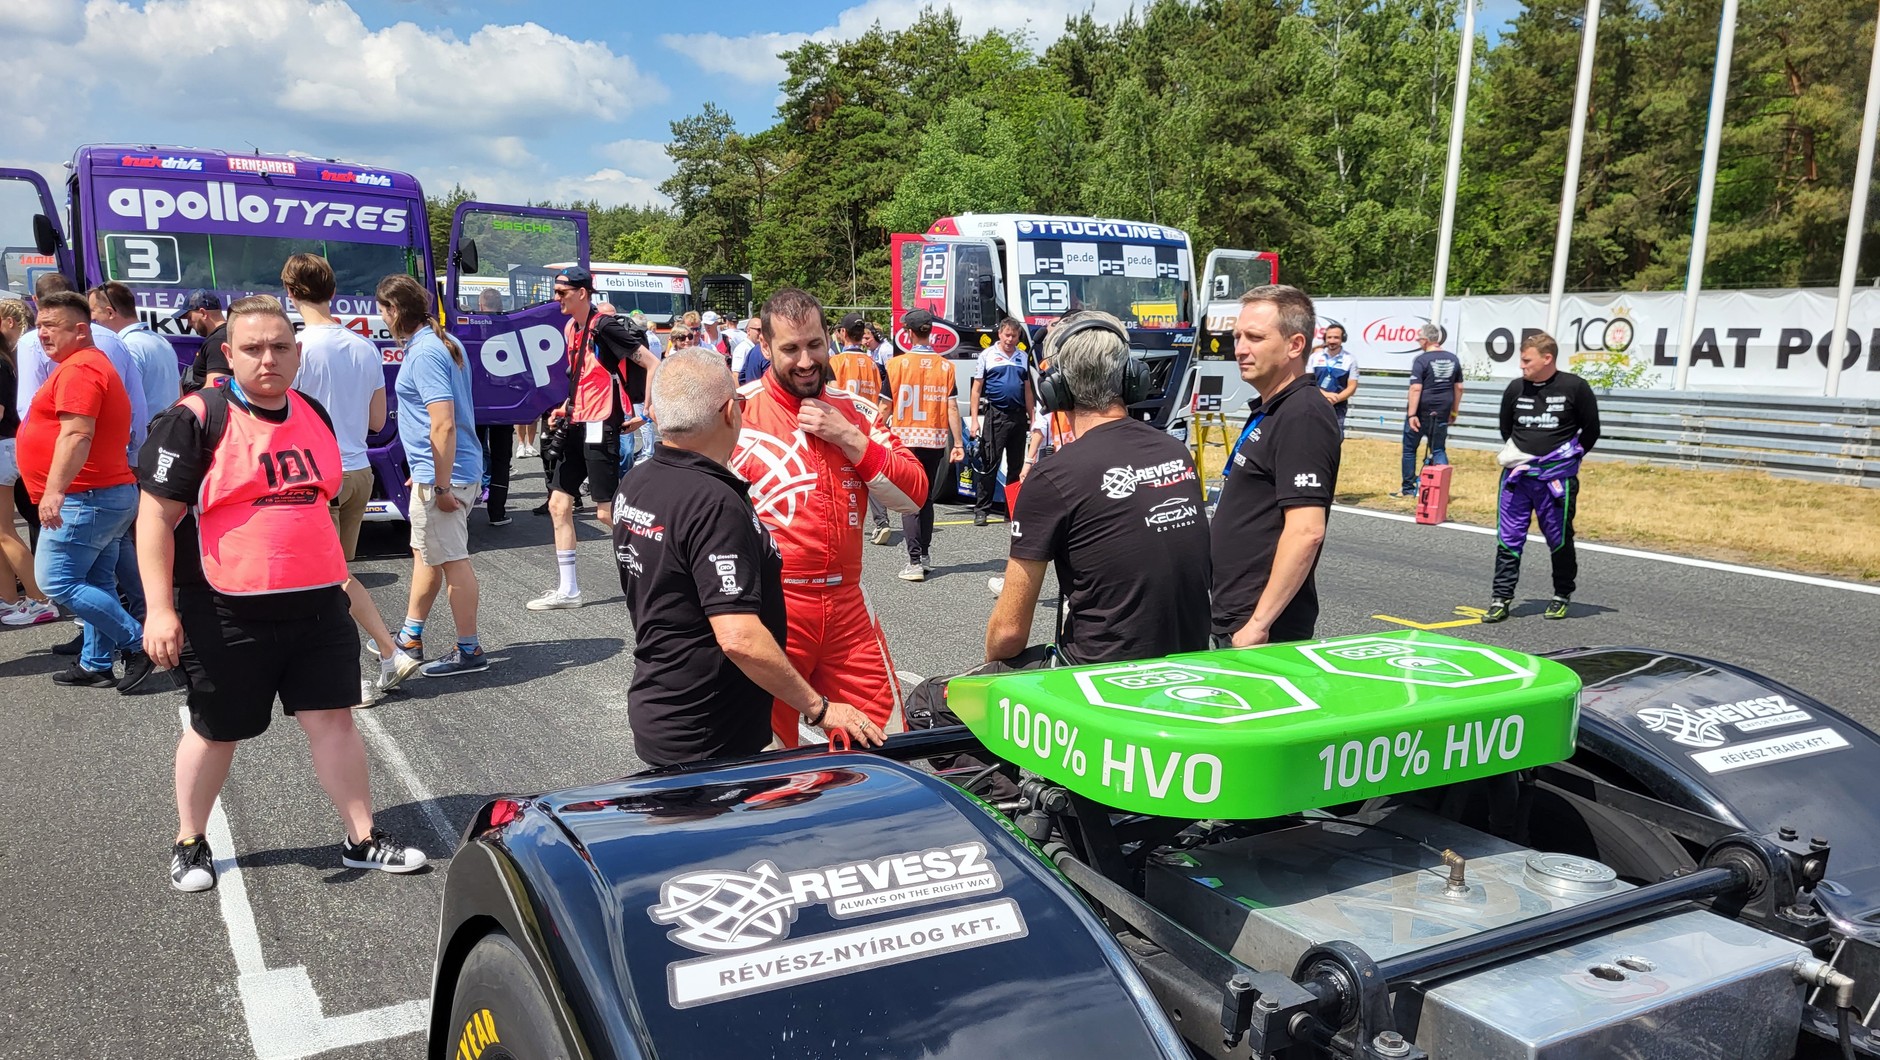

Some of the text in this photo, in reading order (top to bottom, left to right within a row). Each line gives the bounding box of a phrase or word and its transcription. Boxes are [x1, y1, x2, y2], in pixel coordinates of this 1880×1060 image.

[229, 157, 295, 174] FERNFAHRER
[108, 181, 407, 233] apollo TYRES
[493, 219, 552, 233] SASCHA
[1033, 220, 1162, 240] TRUCKLINE
[124, 239, 161, 278] 3
[923, 254, 946, 280] 23
[1036, 257, 1064, 274] PE
[1066, 252, 1095, 264] pe.de
[1100, 259, 1125, 276] PE
[1127, 256, 1153, 266] pe.de
[1156, 262, 1180, 279] PE
[606, 277, 625, 287] febi
[628, 278, 664, 289] bilstein
[137, 292, 187, 308] TEA
[1030, 282, 1069, 311] 23
[1569, 317, 1635, 353] 100
[1653, 327, 1763, 369] LAT
[897, 384, 928, 421] PL
[258, 449, 324, 489] 101
[1153, 471, 1197, 488] RACING
[1294, 473, 1322, 488] #1
[630, 523, 664, 542] ACING
[997, 696, 1224, 805] 100% HVO
[1318, 713, 1525, 792] 100% HVO
[1766, 740, 1806, 756] TRANS
[1804, 736, 1830, 748] KFT.
[839, 877, 991, 911] ALWAYS ON THE RIGHT WAY
[718, 915, 1002, 987] RÉVÉSZ-NYÍRLOG KFT.
[455, 1008, 500, 1060] YEAR
